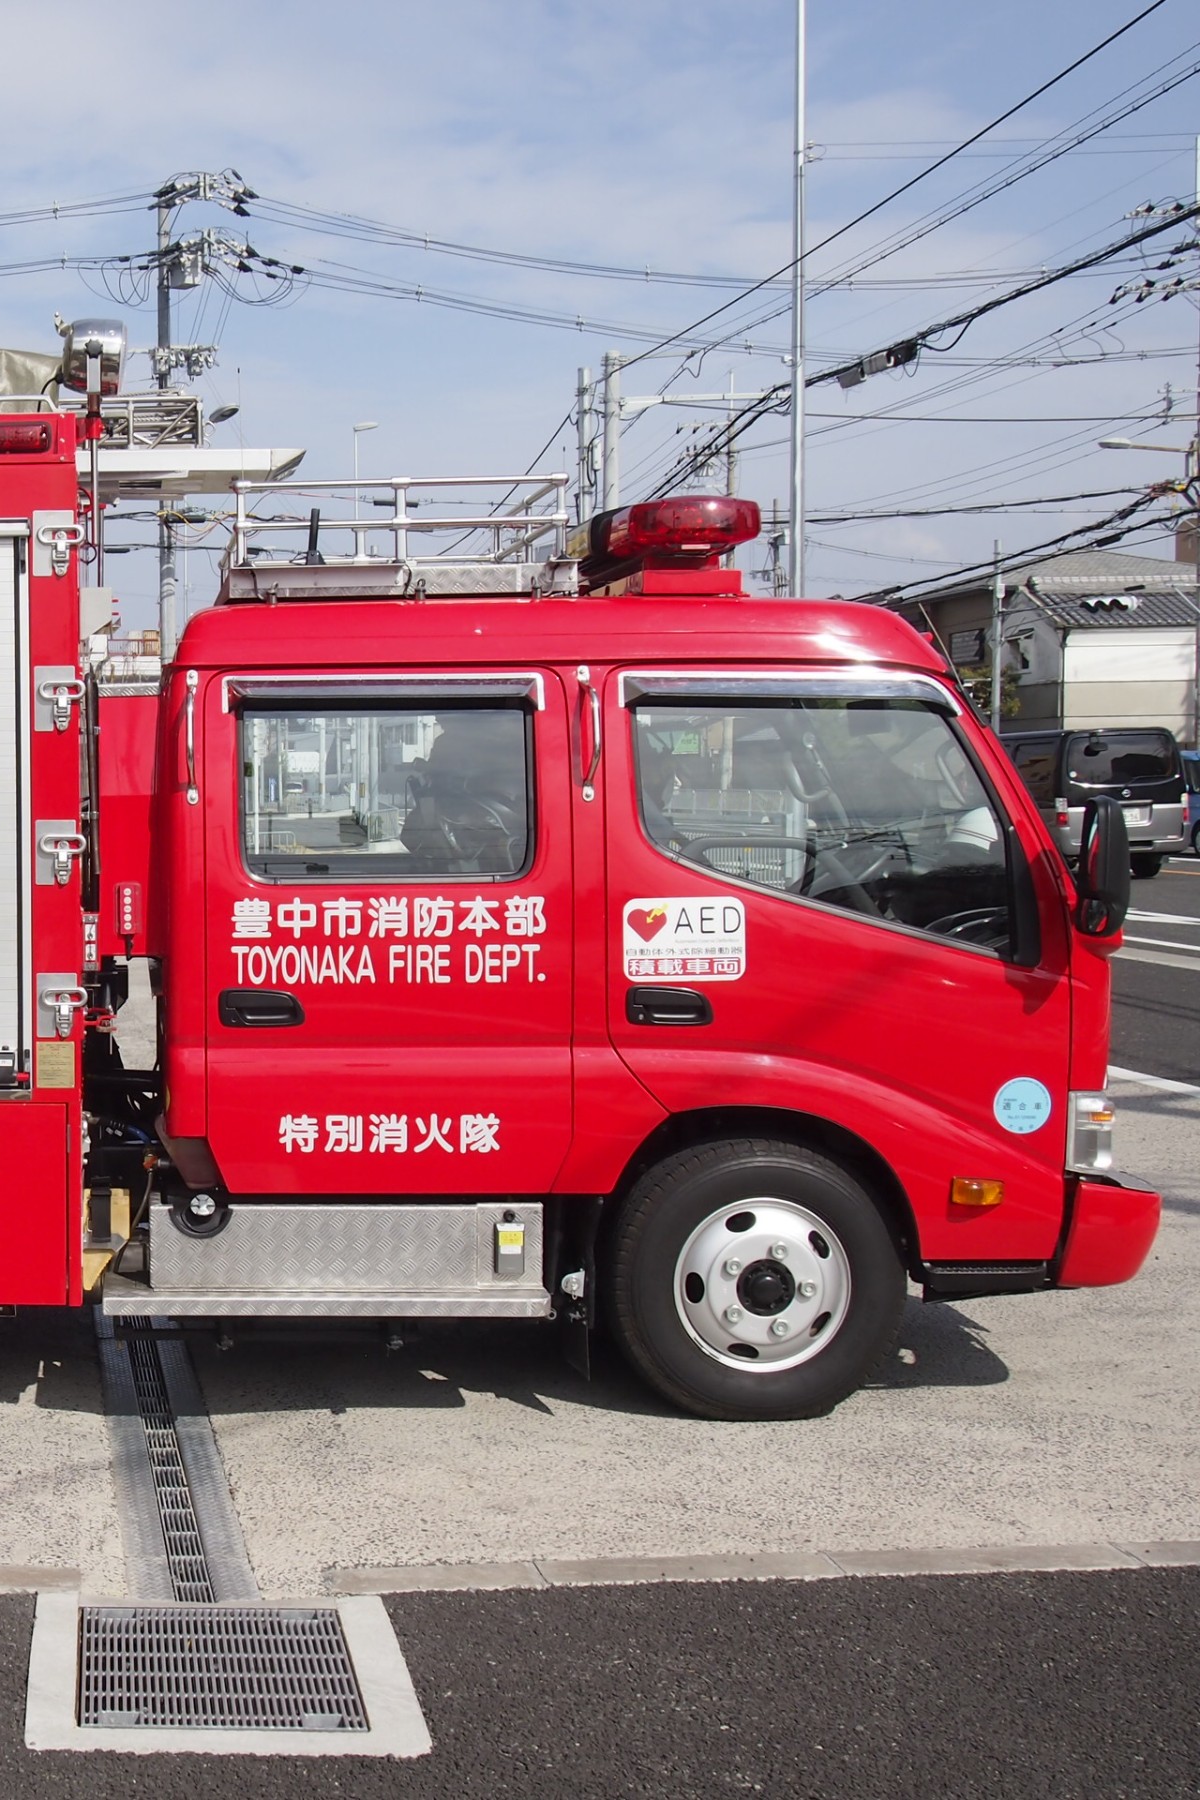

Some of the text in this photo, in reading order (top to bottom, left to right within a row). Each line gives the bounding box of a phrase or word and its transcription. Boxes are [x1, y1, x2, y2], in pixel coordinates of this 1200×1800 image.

[231, 895, 547, 938] 豊中市消防本部
[674, 906, 742, 934] AED
[231, 943, 547, 985] TOYONAKA FIRE DEPT.
[629, 958, 740, 975] 積載車両
[278, 1113, 500, 1154] 特別消火隊
